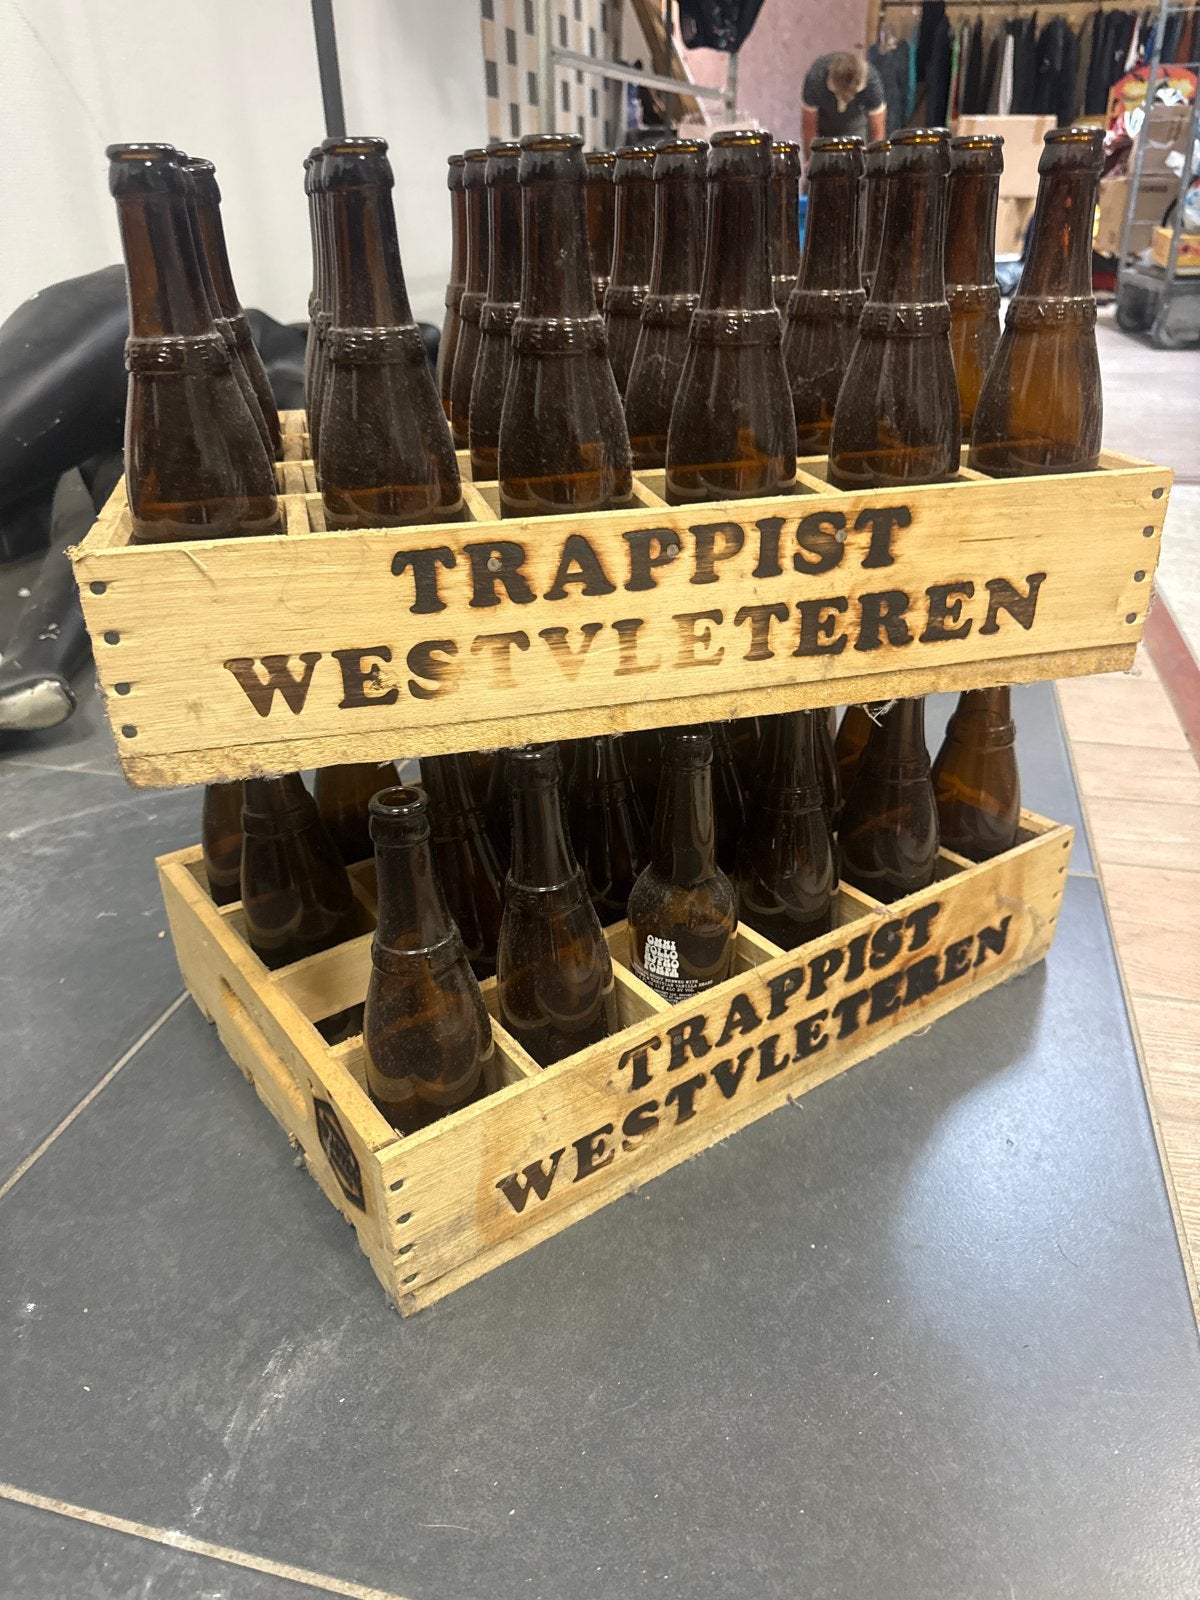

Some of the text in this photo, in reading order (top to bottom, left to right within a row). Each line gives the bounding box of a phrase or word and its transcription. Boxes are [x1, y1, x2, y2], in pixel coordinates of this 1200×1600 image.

[223, 572, 1048, 718] WESTVLETEREN
[390, 505, 912, 615] TRAPPIST
[495, 914, 1013, 1214] WESTVLETEREN
[618, 900, 941, 1094] TRAPPIST
